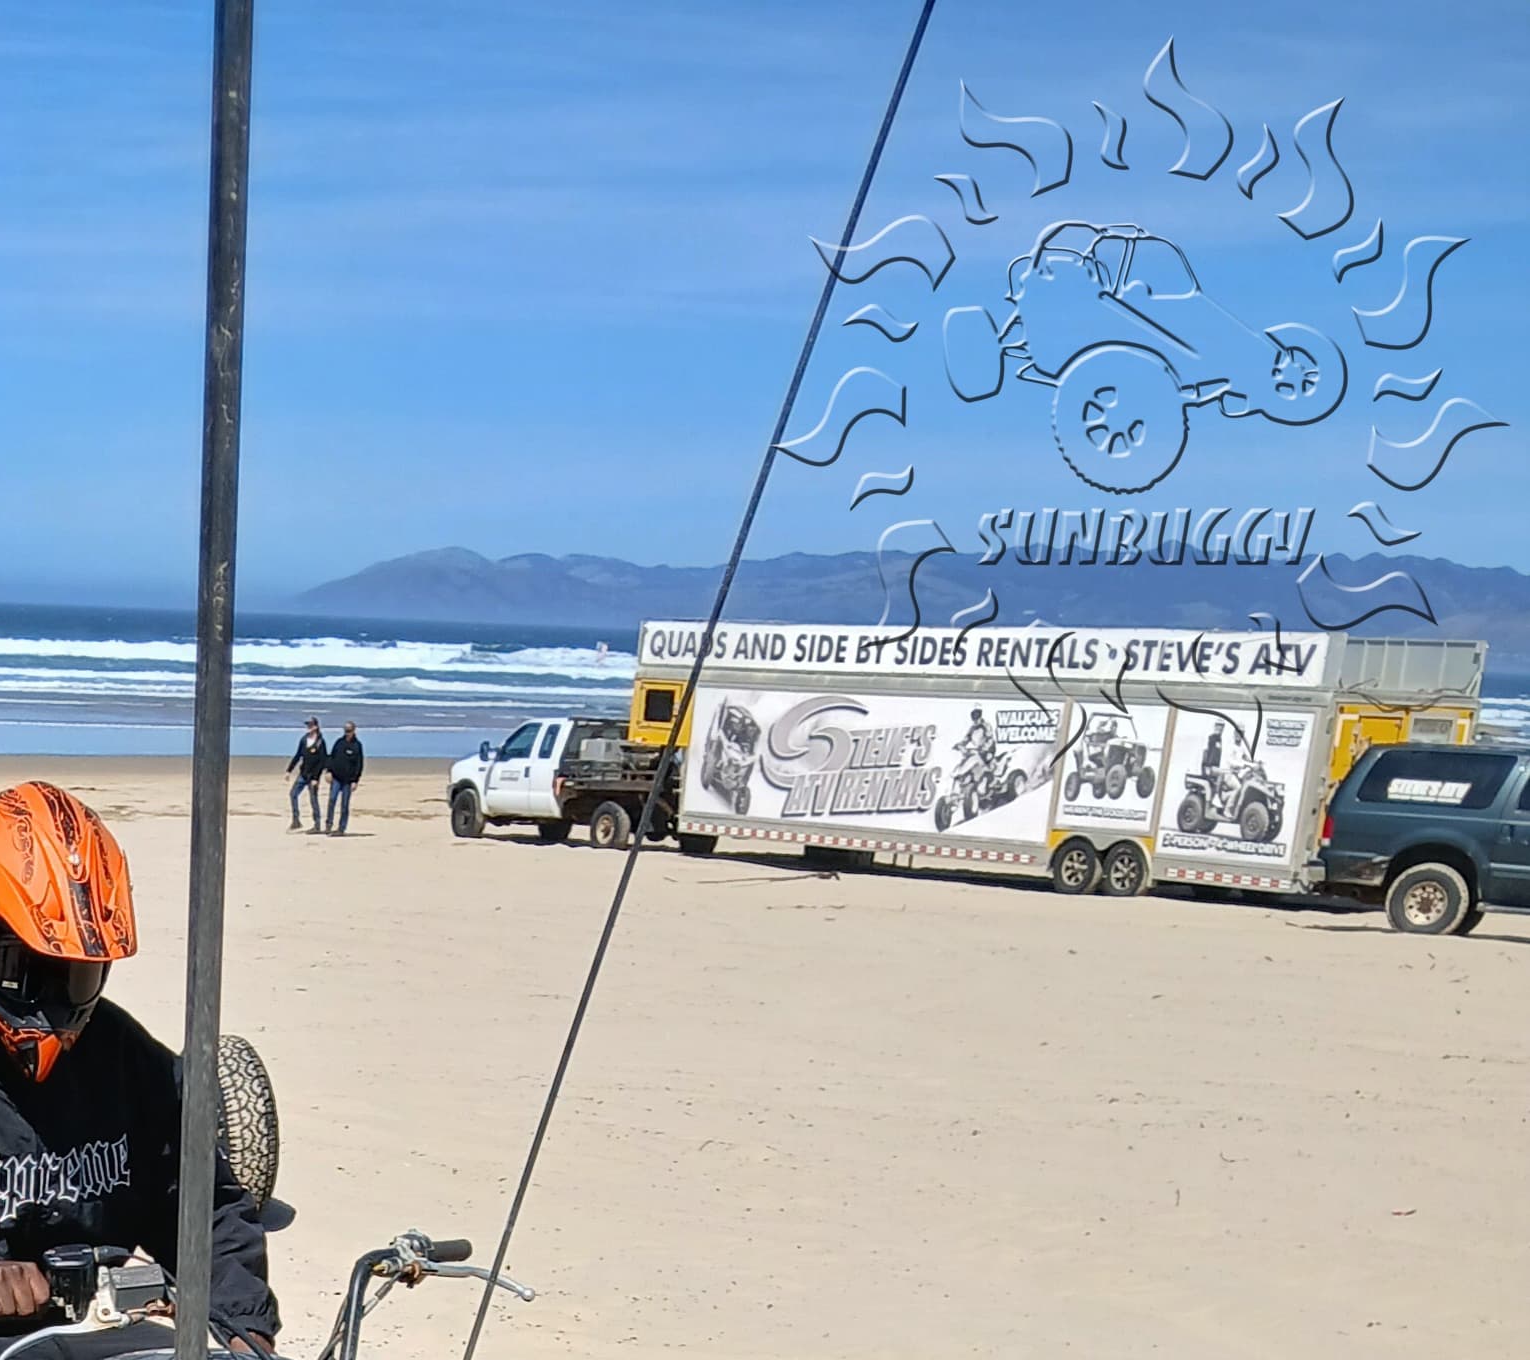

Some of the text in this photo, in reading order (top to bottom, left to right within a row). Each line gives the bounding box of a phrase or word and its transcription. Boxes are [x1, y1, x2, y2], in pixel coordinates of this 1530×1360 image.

[650, 629, 1317, 677] QUADS AND SIDE BY SIDES RENTALS STEVE'S ATV
[996, 726, 1058, 744] WELCOME
[781, 766, 941, 818] ATV RENTALS
